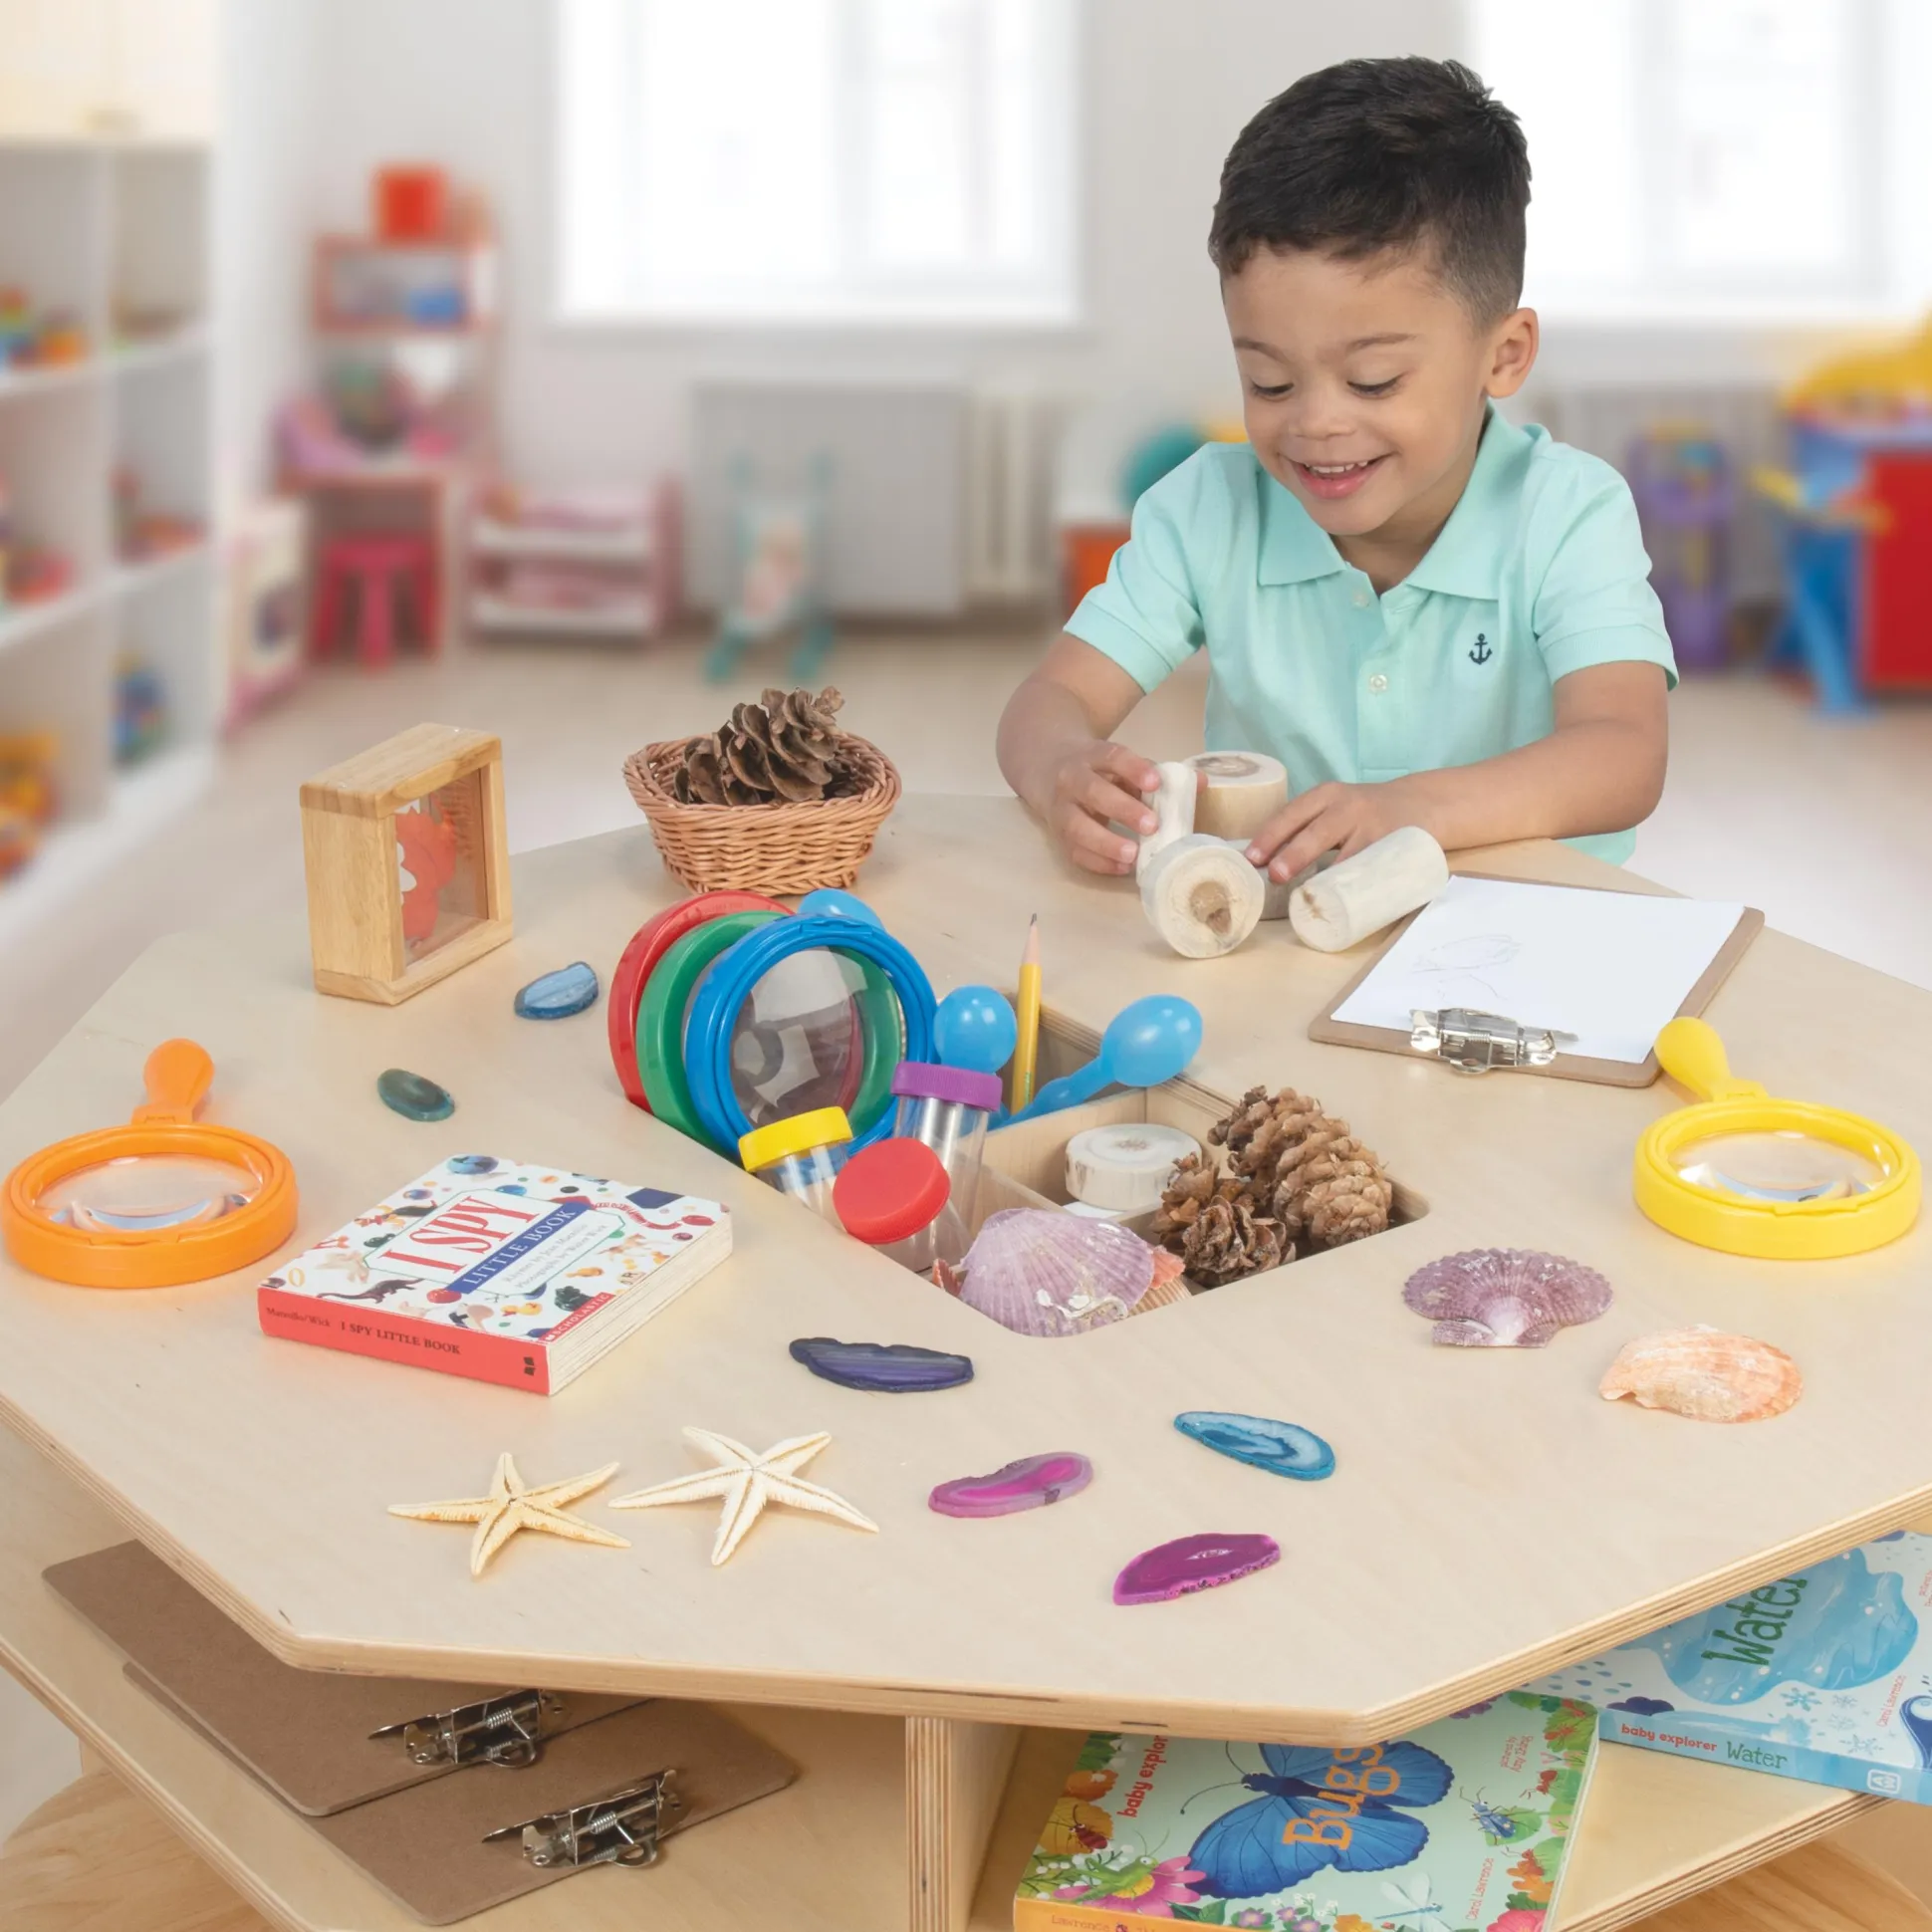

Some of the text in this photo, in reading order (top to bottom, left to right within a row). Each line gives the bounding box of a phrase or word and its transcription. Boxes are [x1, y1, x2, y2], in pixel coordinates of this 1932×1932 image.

[377, 1195, 541, 1274] I SPY
[462, 1208, 576, 1285] LITTLE BOOK
[341, 1321, 347, 1331] I
[350, 1324, 373, 1336] SPY
[376, 1328, 421, 1346] LITTLE
[423, 1337, 461, 1354] BOOK
[556, 1293, 610, 1336] SCHOLASTIC
[1116, 1735, 1168, 1817] baby explor
[1620, 1723, 1789, 1770] baby explorer Water
[1282, 1744, 1401, 1850] Bugs
[1466, 1899, 1483, 1921] Carol
